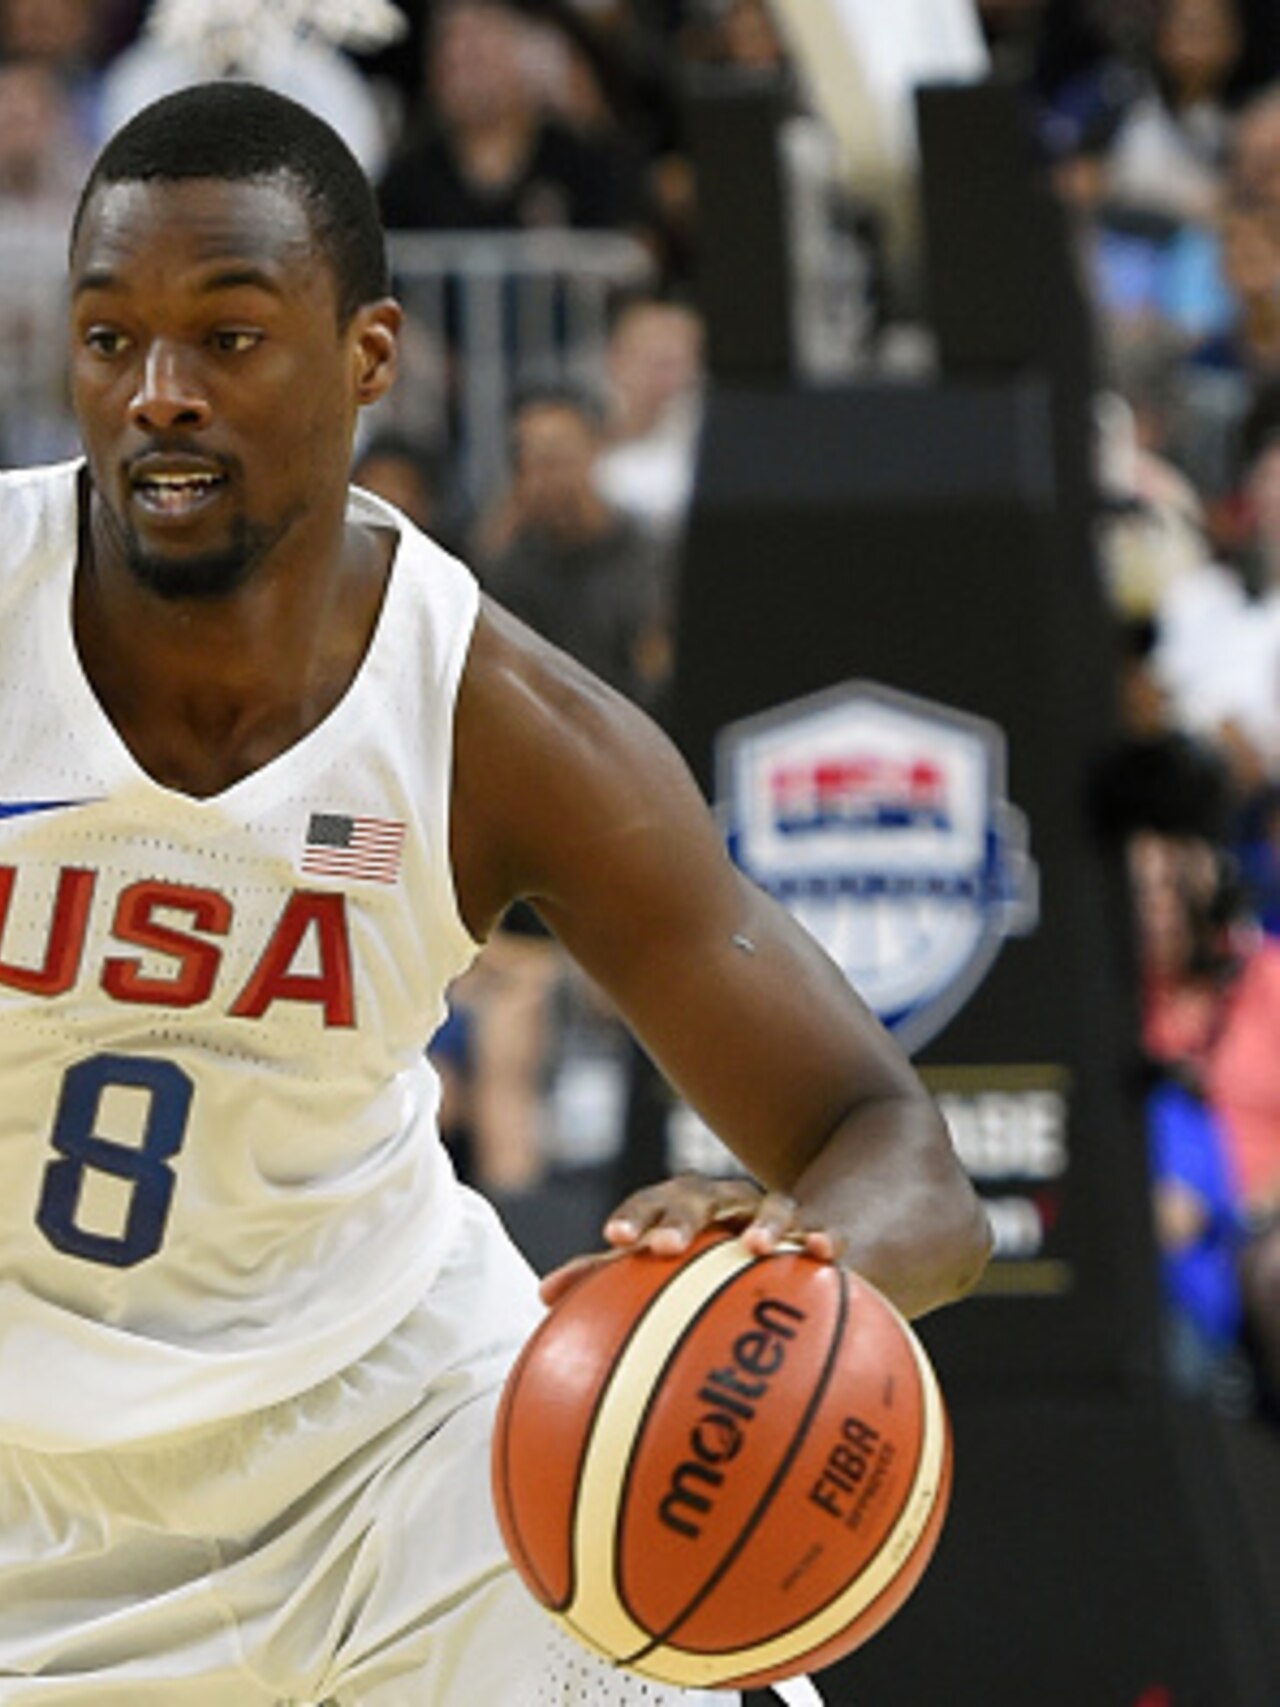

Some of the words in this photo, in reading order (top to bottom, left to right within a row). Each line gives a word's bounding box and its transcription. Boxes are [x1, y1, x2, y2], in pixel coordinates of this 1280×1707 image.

[34, 1051, 196, 1270] 8
[657, 1296, 807, 1540] molten
[808, 1416, 880, 1519] FIBA
